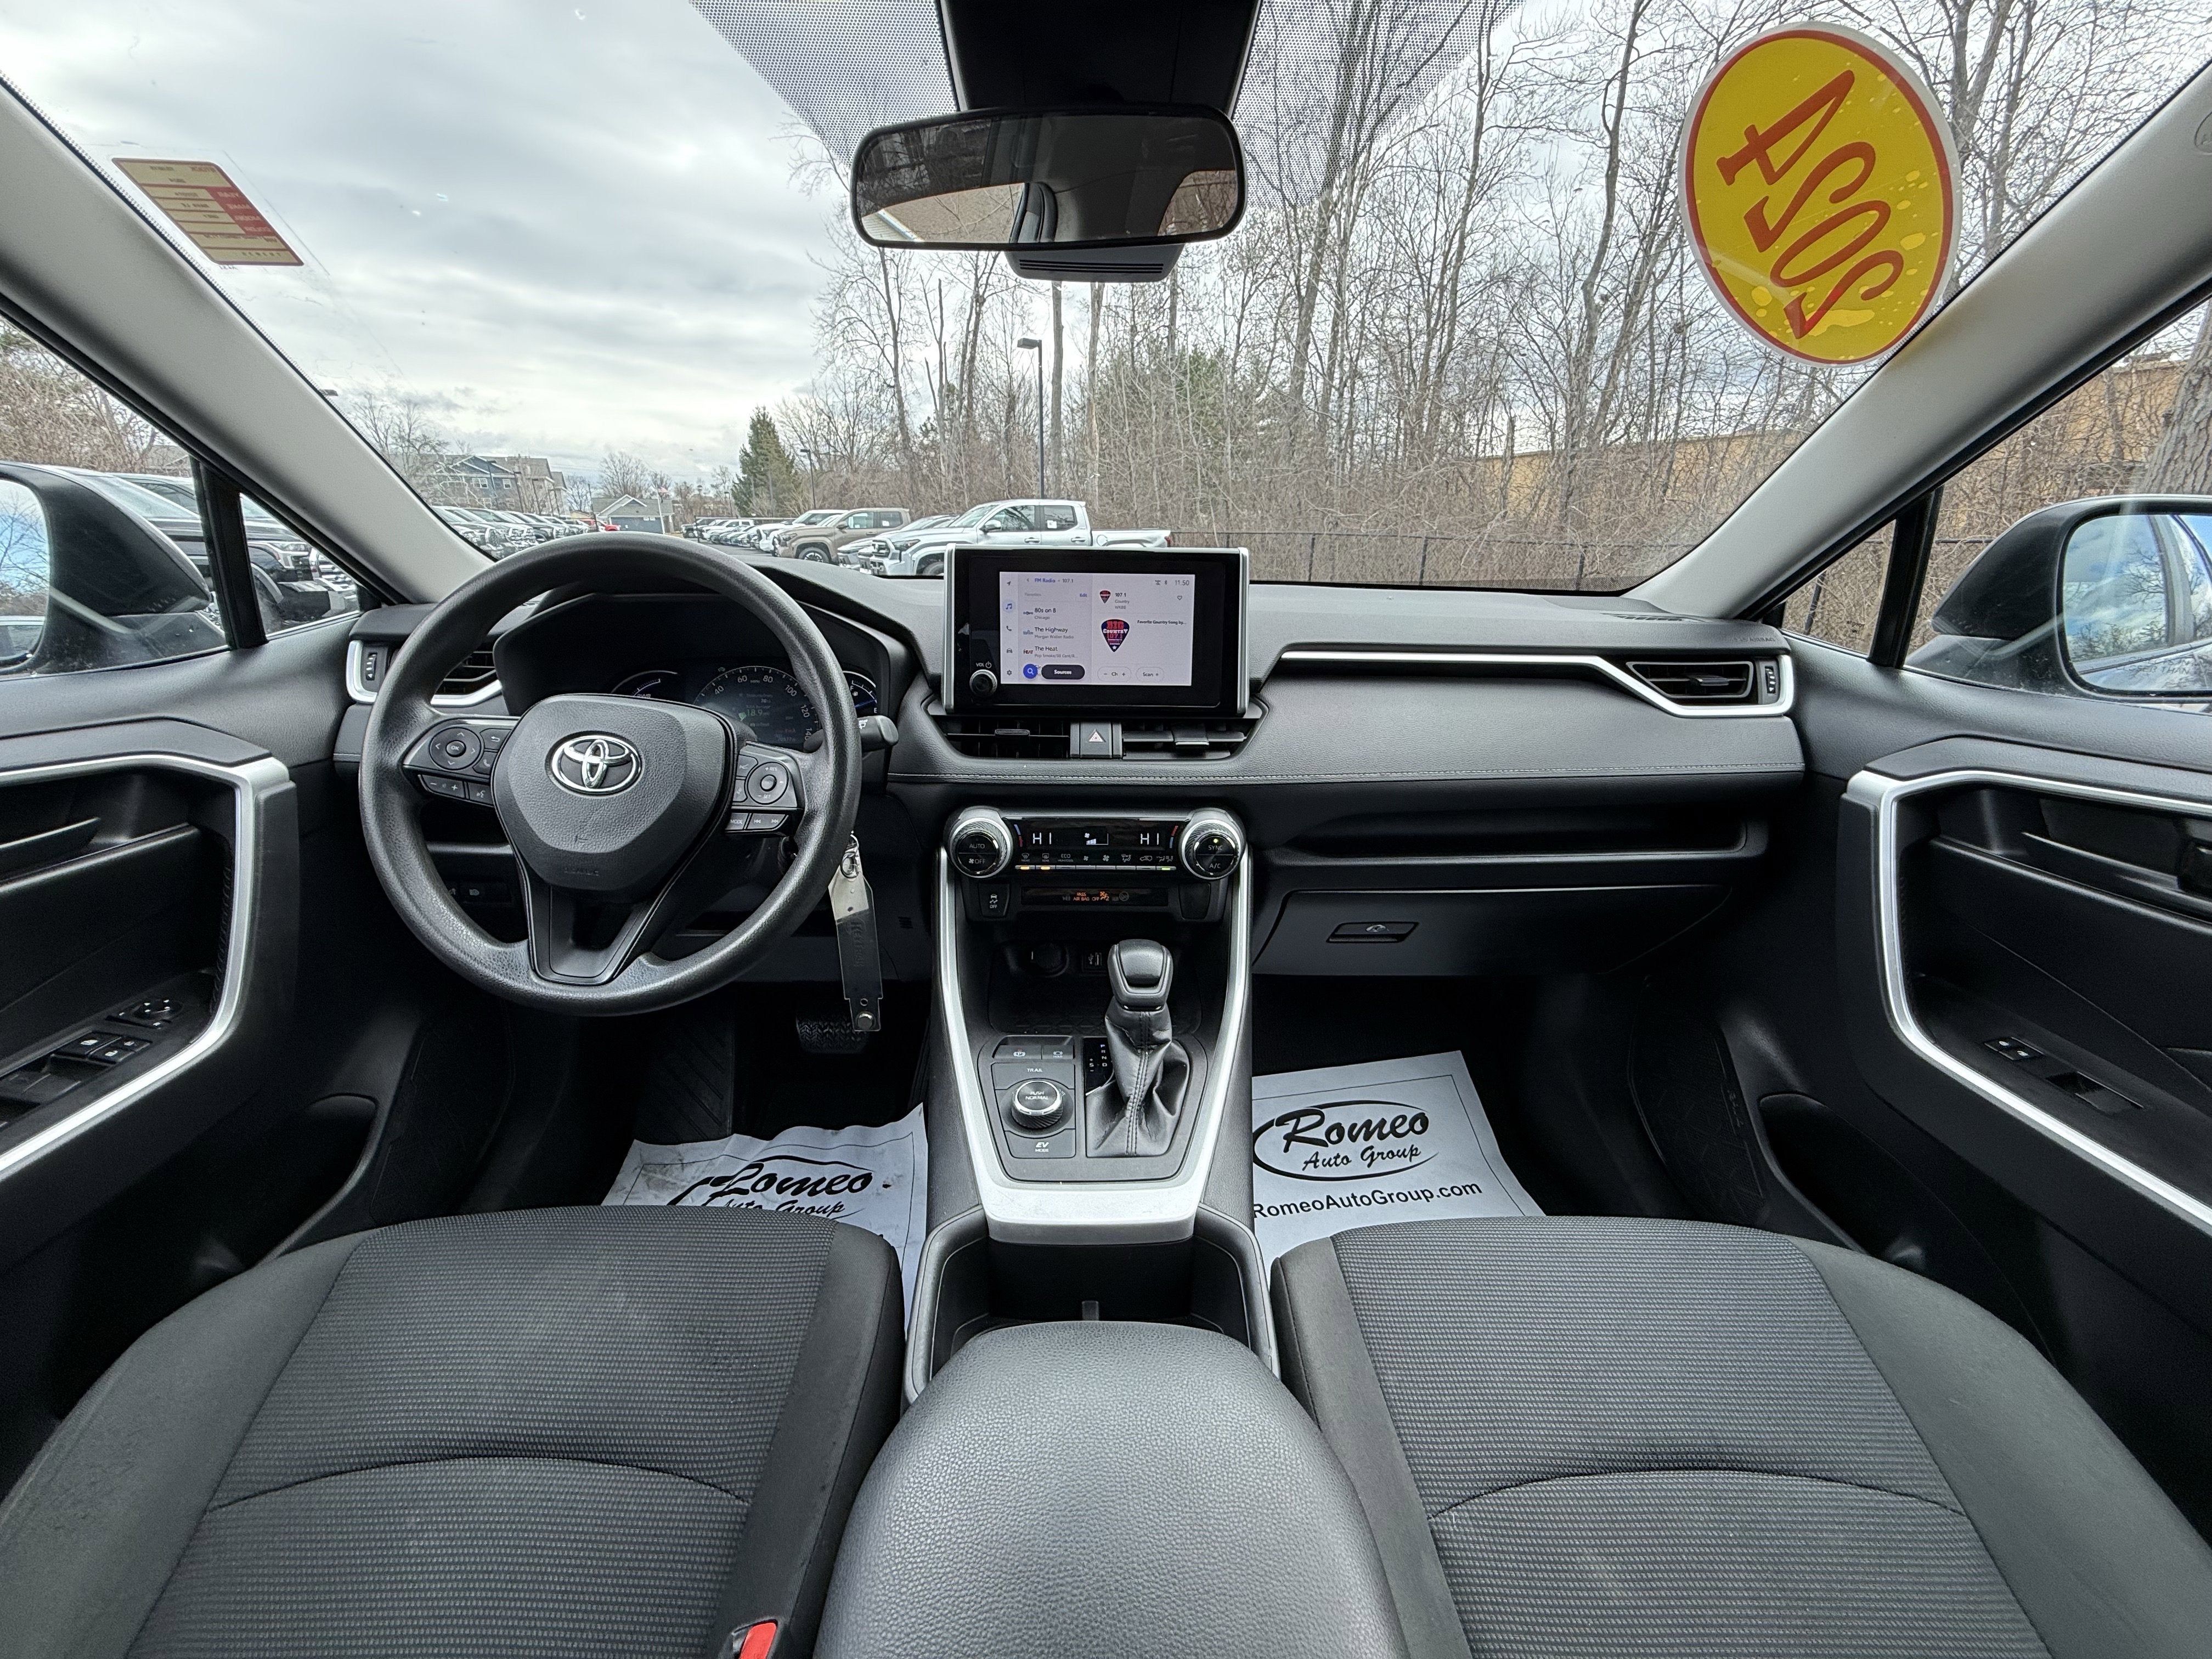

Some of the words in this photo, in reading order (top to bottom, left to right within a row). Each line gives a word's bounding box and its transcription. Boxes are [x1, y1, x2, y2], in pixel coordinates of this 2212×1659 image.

[1107, 620, 1124, 629] BIG
[737, 675, 748, 683] 60
[763, 675, 773, 683] 80
[714, 685, 724, 695] 40
[785, 685, 797, 697] 100
[800, 704, 810, 718] 120
[1274, 1108, 1429, 1153] Romeo
[1302, 1151, 1352, 1171] Auto
[1361, 1144, 1421, 1169] Group
[1254, 1181, 1483, 1218] RomeoAutoGroup.com
